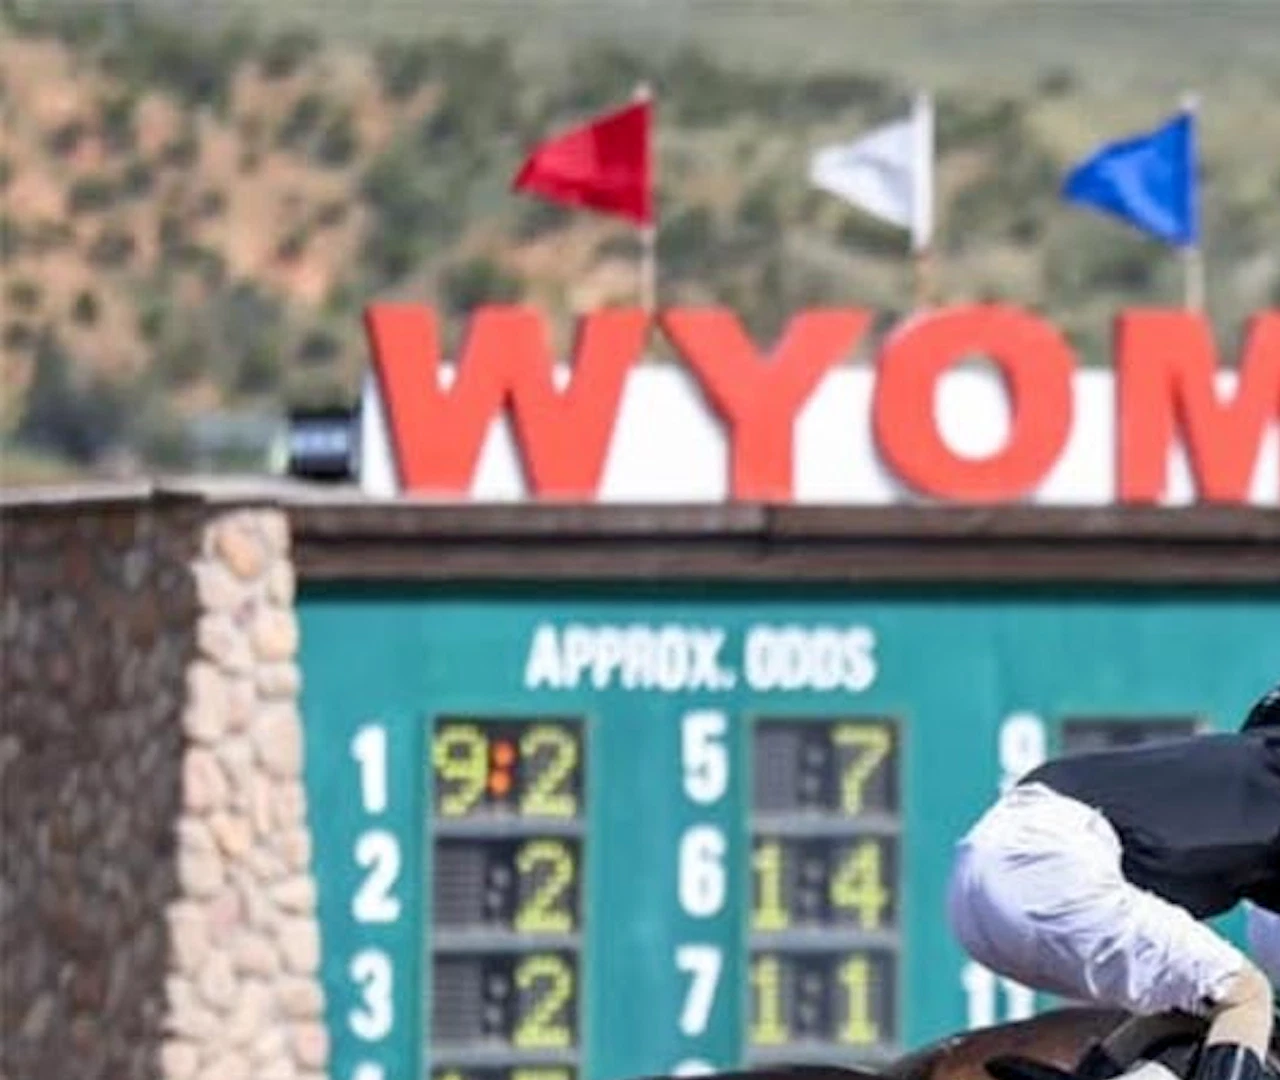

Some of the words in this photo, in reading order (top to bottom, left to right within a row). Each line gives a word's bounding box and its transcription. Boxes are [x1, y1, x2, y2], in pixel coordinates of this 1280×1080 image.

[525, 626, 735, 690] APPROX.
[745, 626, 876, 691] ODDS
[350, 724, 386, 813] 1
[681, 710, 728, 803] 5
[830, 724, 890, 815] 7
[353, 830, 399, 923] 2
[515, 840, 573, 935] 2
[678, 825, 726, 918] 6
[349, 949, 393, 1040] 3
[514, 955, 572, 1050] 2
[676, 944, 724, 1035] 7
